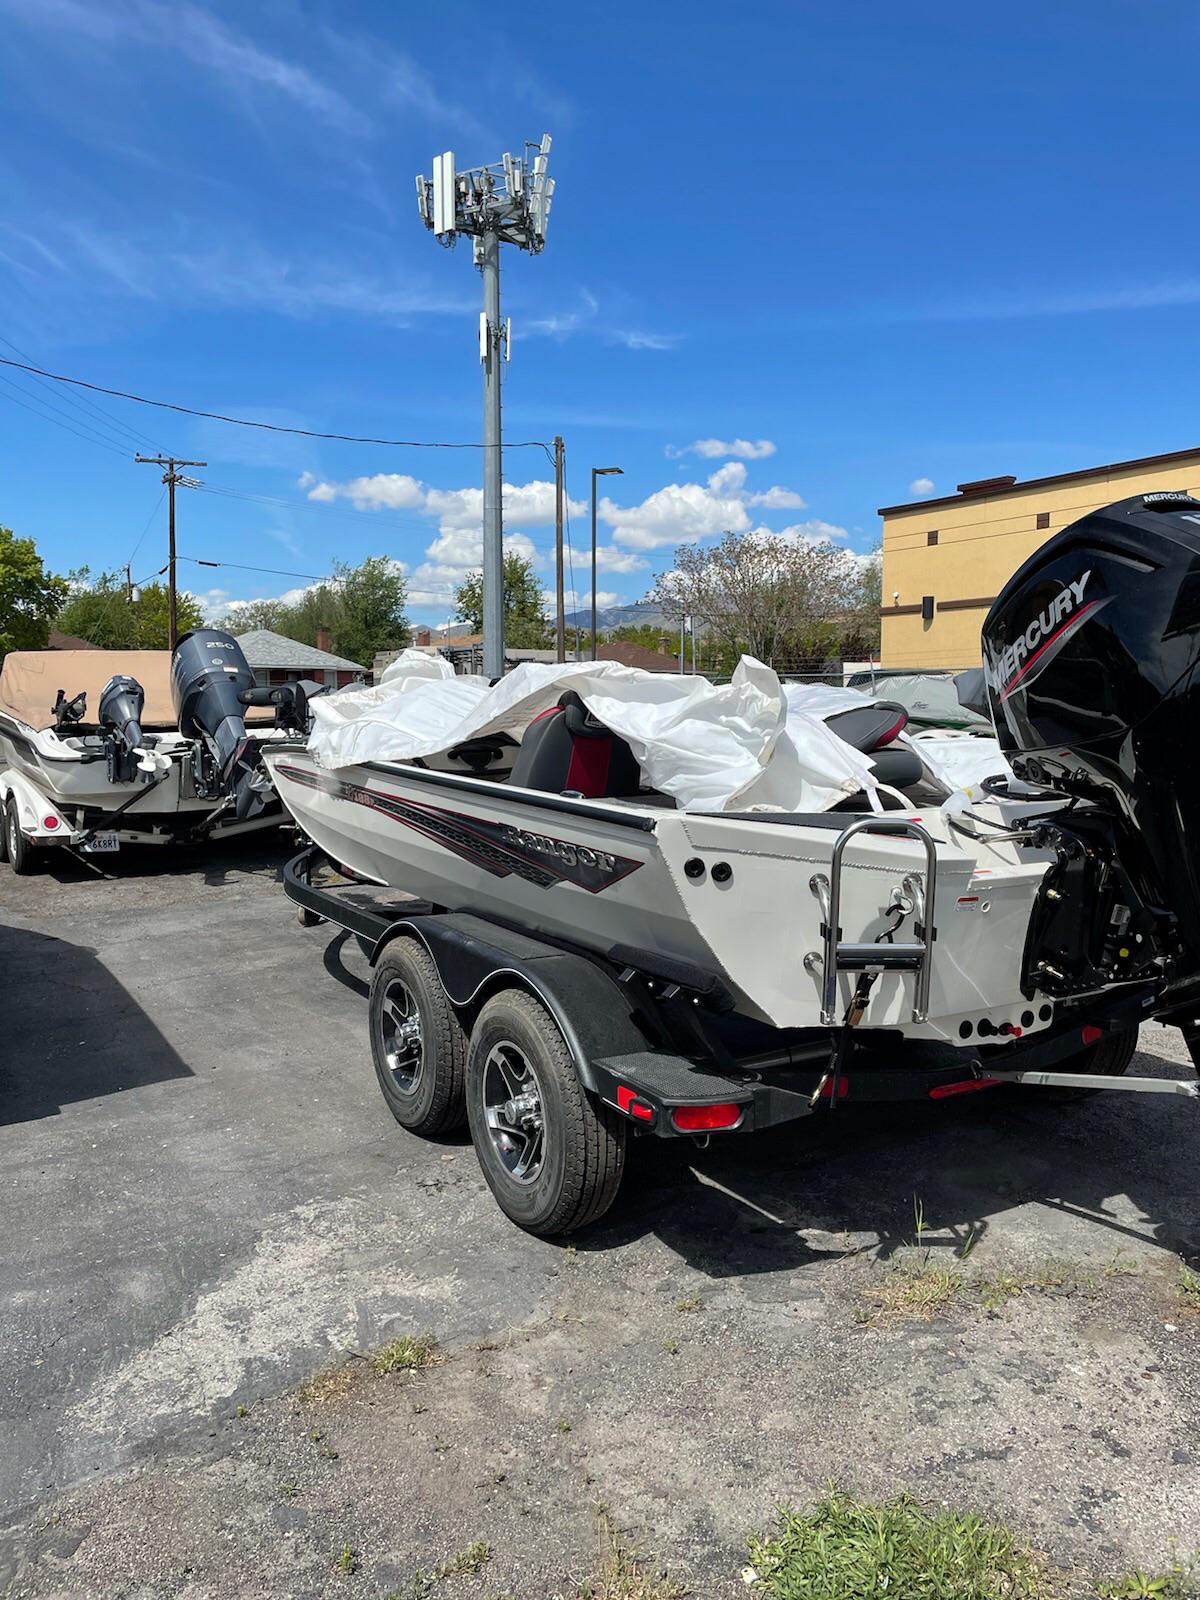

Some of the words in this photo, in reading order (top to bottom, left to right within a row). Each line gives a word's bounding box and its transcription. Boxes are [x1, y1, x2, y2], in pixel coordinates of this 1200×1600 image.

[1143, 493, 1193, 503] MERCURY
[206, 641, 235, 650] 250
[992, 570, 1091, 695] MERCURY
[498, 822, 616, 873] Ranger
